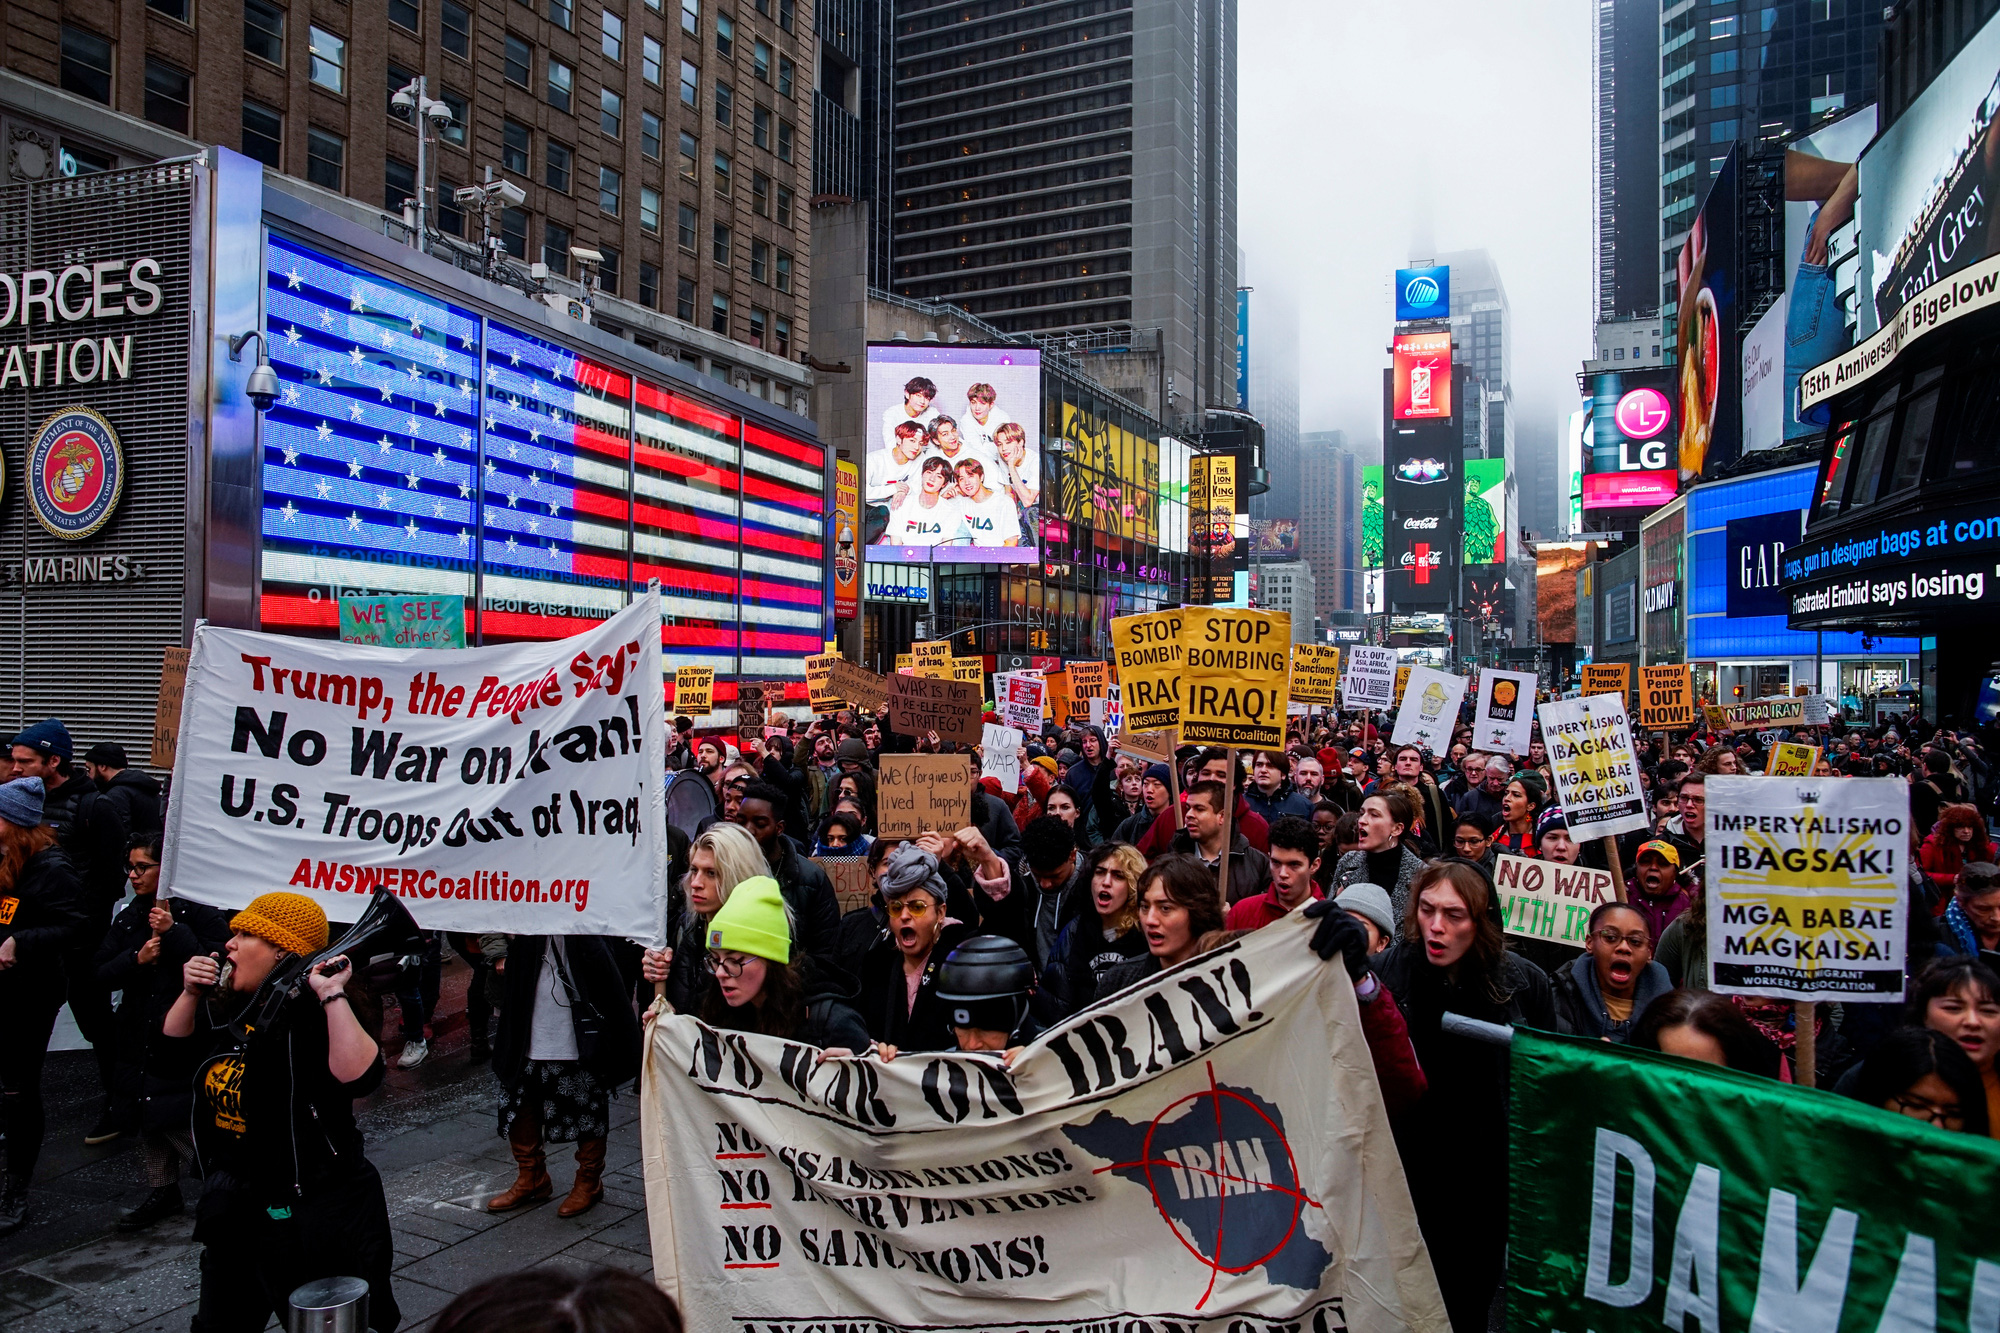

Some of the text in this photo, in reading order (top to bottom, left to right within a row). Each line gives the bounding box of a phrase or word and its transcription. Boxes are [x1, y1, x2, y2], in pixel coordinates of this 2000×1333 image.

[1949, 164, 1965, 193] SINCE
[1804, 271, 1999, 400] 75th Anniversary of Bigelow
[1751, 343, 1761, 365] Our
[1744, 357, 1773, 397] Denim Now
[35, 419, 114, 476] DEPARTMENT OF THE NAVY
[1619, 441, 1667, 471] LG
[836, 466, 857, 489] BUBBA
[1213, 475, 1231, 485] LION
[36, 473, 114, 526] UNITED STATES MARINE CORPS
[836, 488, 856, 508] GUMP
[1212, 485, 1234, 498] KING
[1621, 486, 1661, 494] www.LG.com
[906, 520, 941, 535] FILA
[965, 514, 994, 531] FILA
[1804, 519, 1948, 578] gun in designer bags at
[25, 555, 132, 583] MARINES
[1740, 541, 1785, 590] GAP
[867, 583, 928, 599] VIACOMCBS
[1645, 580, 1675, 614] OLD NAVY
[1793, 569, 1984, 615] Frustrated Embiid says losing
[352, 601, 443, 624] WE SEE
[1062, 610, 1085, 632] KEY
[395, 626, 450, 644] other's
[1131, 618, 1182, 644] STOP
[1205, 617, 1270, 644] STOP
[916, 645, 947, 656] U.S. OUT
[1188, 648, 1284, 672] BOMBING
[1299, 646, 1335, 658] No War
[1355, 650, 1385, 660] U.S. OUT
[691, 668, 713, 676] TROOPS
[808, 660, 817, 670] NO
[838, 661, 885, 685] TRUMP
[918, 658, 926, 667] of
[968, 668, 981, 679] OF
[1069, 663, 1104, 675] Trump/
[1294, 661, 1335, 675] Sanctions
[1370, 667, 1390, 675] AMERICA
[1587, 667, 1626, 678] Trump/
[1643, 666, 1686, 679] Trump/
[241, 653, 393, 723] Trump,
[408, 671, 465, 718] the
[467, 667, 562, 725] People
[678, 677, 711, 688] OUT OF
[895, 677, 968, 699] WAR IS NOT
[1073, 675, 1102, 684] Pence
[1294, 676, 1332, 687] on Iran!
[1349, 677, 1366, 695] NO
[1589, 678, 1622, 688] Pence
[1647, 680, 1684, 689] Pence
[680, 692, 707, 705] IRAQ!
[746, 689, 756, 699] NO
[828, 686, 847, 699] AND
[852, 693, 877, 710] LIES
[1075, 684, 1102, 698] OUT
[1649, 690, 1683, 706] OUT
[892, 695, 972, 717] A RE-ELECTION
[1189, 684, 1277, 725] IRAQ!
[1644, 706, 1690, 724] NOW!
[1747, 705, 1770, 721] IRAQ
[1770, 703, 1801, 718] IRAN
[743, 714, 759, 726] WITH
[899, 711, 965, 733] STRATEGY
[1130, 713, 1167, 727] ANSWER
[1419, 714, 1438, 723] RESIST
[1545, 714, 1624, 737] IMPERYALISMO
[231, 706, 327, 766] No
[351, 727, 448, 783] War
[461, 746, 512, 785] on
[515, 694, 642, 779] Iran!
[991, 729, 1012, 749] NO
[1131, 735, 1158, 750] DEATH
[1184, 725, 1280, 743] ANSWER Coalition
[1552, 733, 1626, 760] IBAGSAK!
[982, 754, 1016, 774] WAR
[1560, 763, 1632, 787] MGA BABAE
[1778, 761, 1808, 773] Don't
[880, 763, 970, 790] We (forgive us)
[881, 790, 967, 817] lived happily
[1564, 785, 1635, 807] MAGKAISA!
[220, 774, 562, 856] U.S. Troops Out of
[879, 813, 960, 836] during the war
[1714, 814, 1902, 836] IMPERYALISMO
[1721, 845, 1894, 874] IBAGSAK!
[290, 858, 589, 912] ANSWERCoalition.org
[1498, 860, 1611, 905] NO WAR
[1501, 895, 1557, 938] WITH
[1723, 905, 1892, 929] MGA BABAE
[1724, 935, 1891, 961] MAGKAISA!
[1754, 965, 1812, 979] DAMAYAN
[1743, 977, 1876, 992] WORKERS ASSOCIATION
[688, 958, 1265, 1127] NO WAR ON IRAN!
[715, 1122, 762, 1153] NO
[1163, 1137, 1273, 1200] IRAN
[718, 1169, 771, 1203] NO
[722, 1224, 1050, 1284] NO SANCTIONS!
